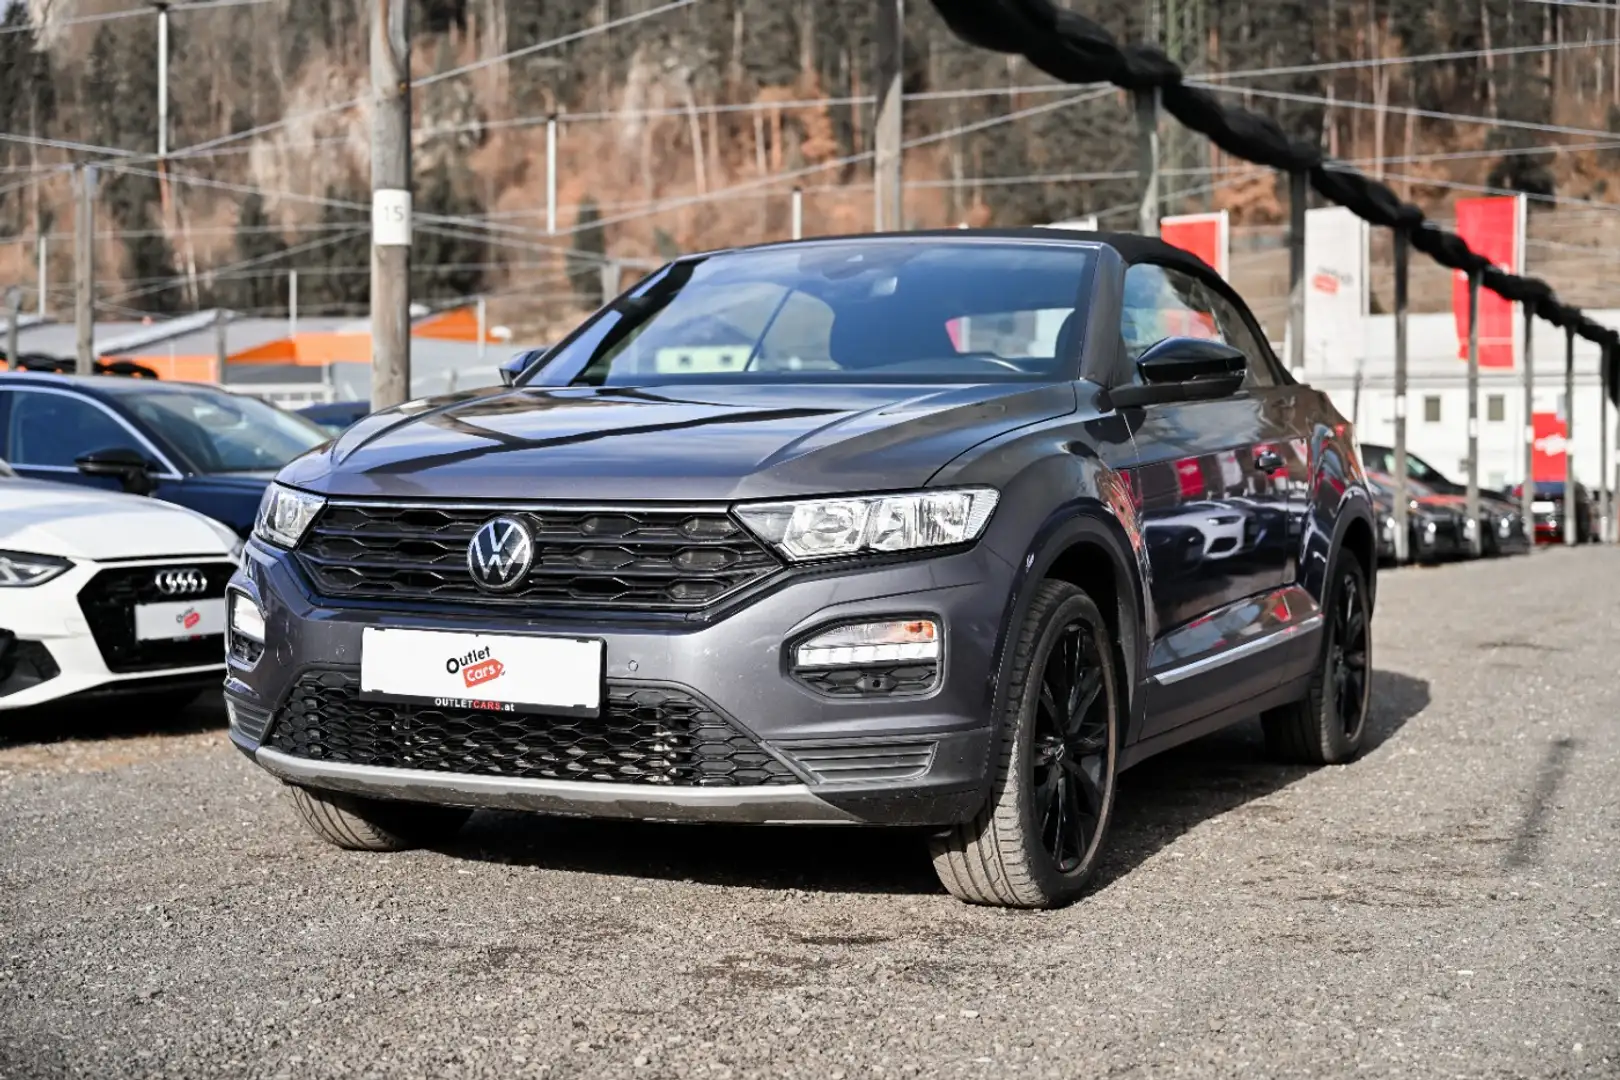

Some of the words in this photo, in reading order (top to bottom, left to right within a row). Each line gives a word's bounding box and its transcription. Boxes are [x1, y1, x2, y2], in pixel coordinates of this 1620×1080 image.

[384, 205, 404, 222] 15
[446, 646, 490, 674] Outlet
[466, 664, 496, 682] Cars
[434, 698, 515, 711] OUTLETCARS.at
